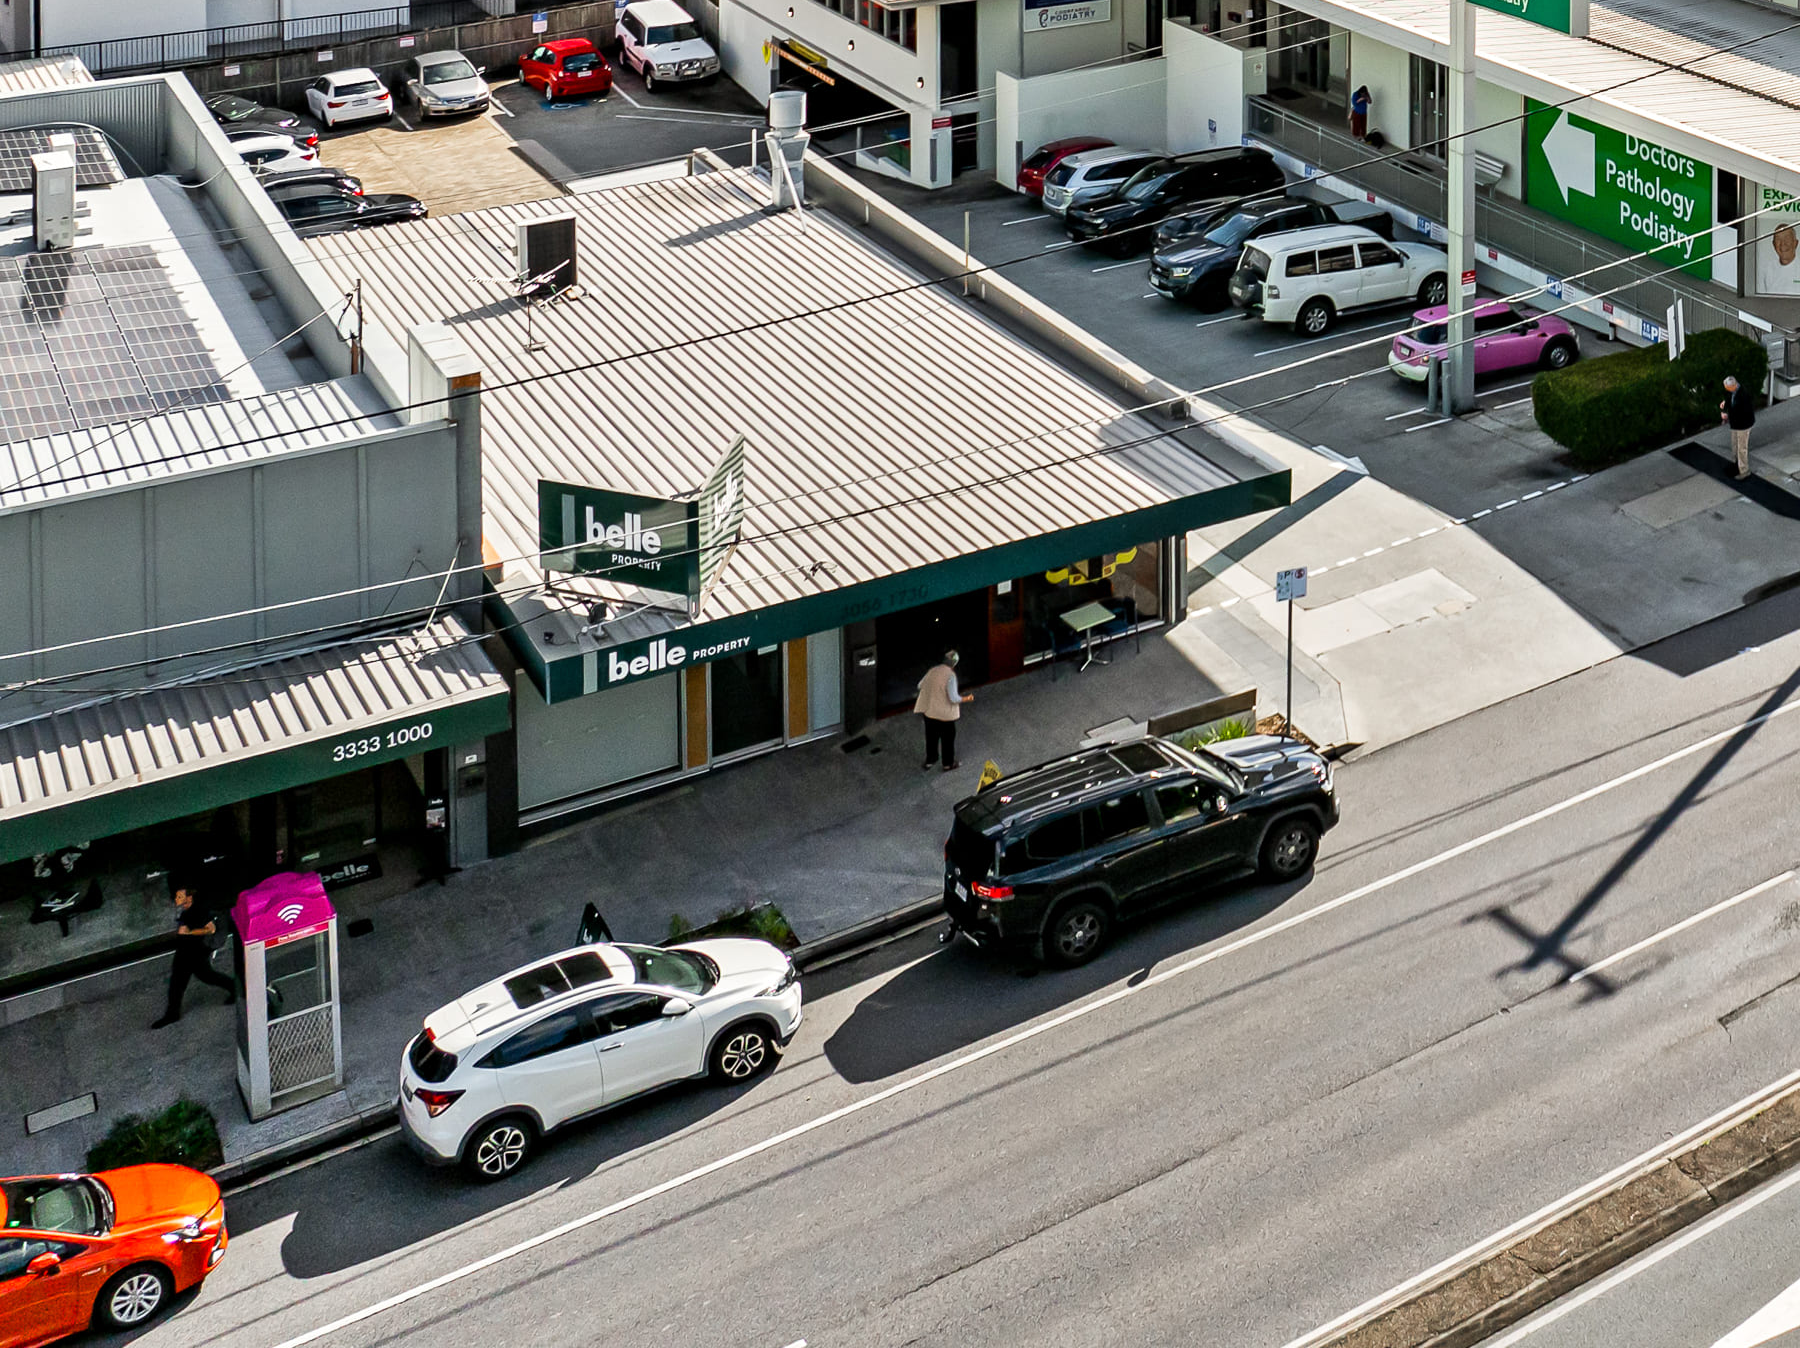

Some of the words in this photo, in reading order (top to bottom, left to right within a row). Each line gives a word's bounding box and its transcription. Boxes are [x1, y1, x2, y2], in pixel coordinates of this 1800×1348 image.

[1050, 10, 1096, 23] PODIATRY
[1625, 133, 1695, 179] Doctors
[1606, 158, 1695, 222] Pathology
[1620, 200, 1695, 260] Podiatry
[585, 505, 661, 555] belle
[611, 553, 661, 572] PROPERTY
[609, 638, 687, 683] belle
[693, 636, 751, 661] PROPERTY
[333, 735, 381, 762] 3333
[386, 723, 433, 748] 1000
